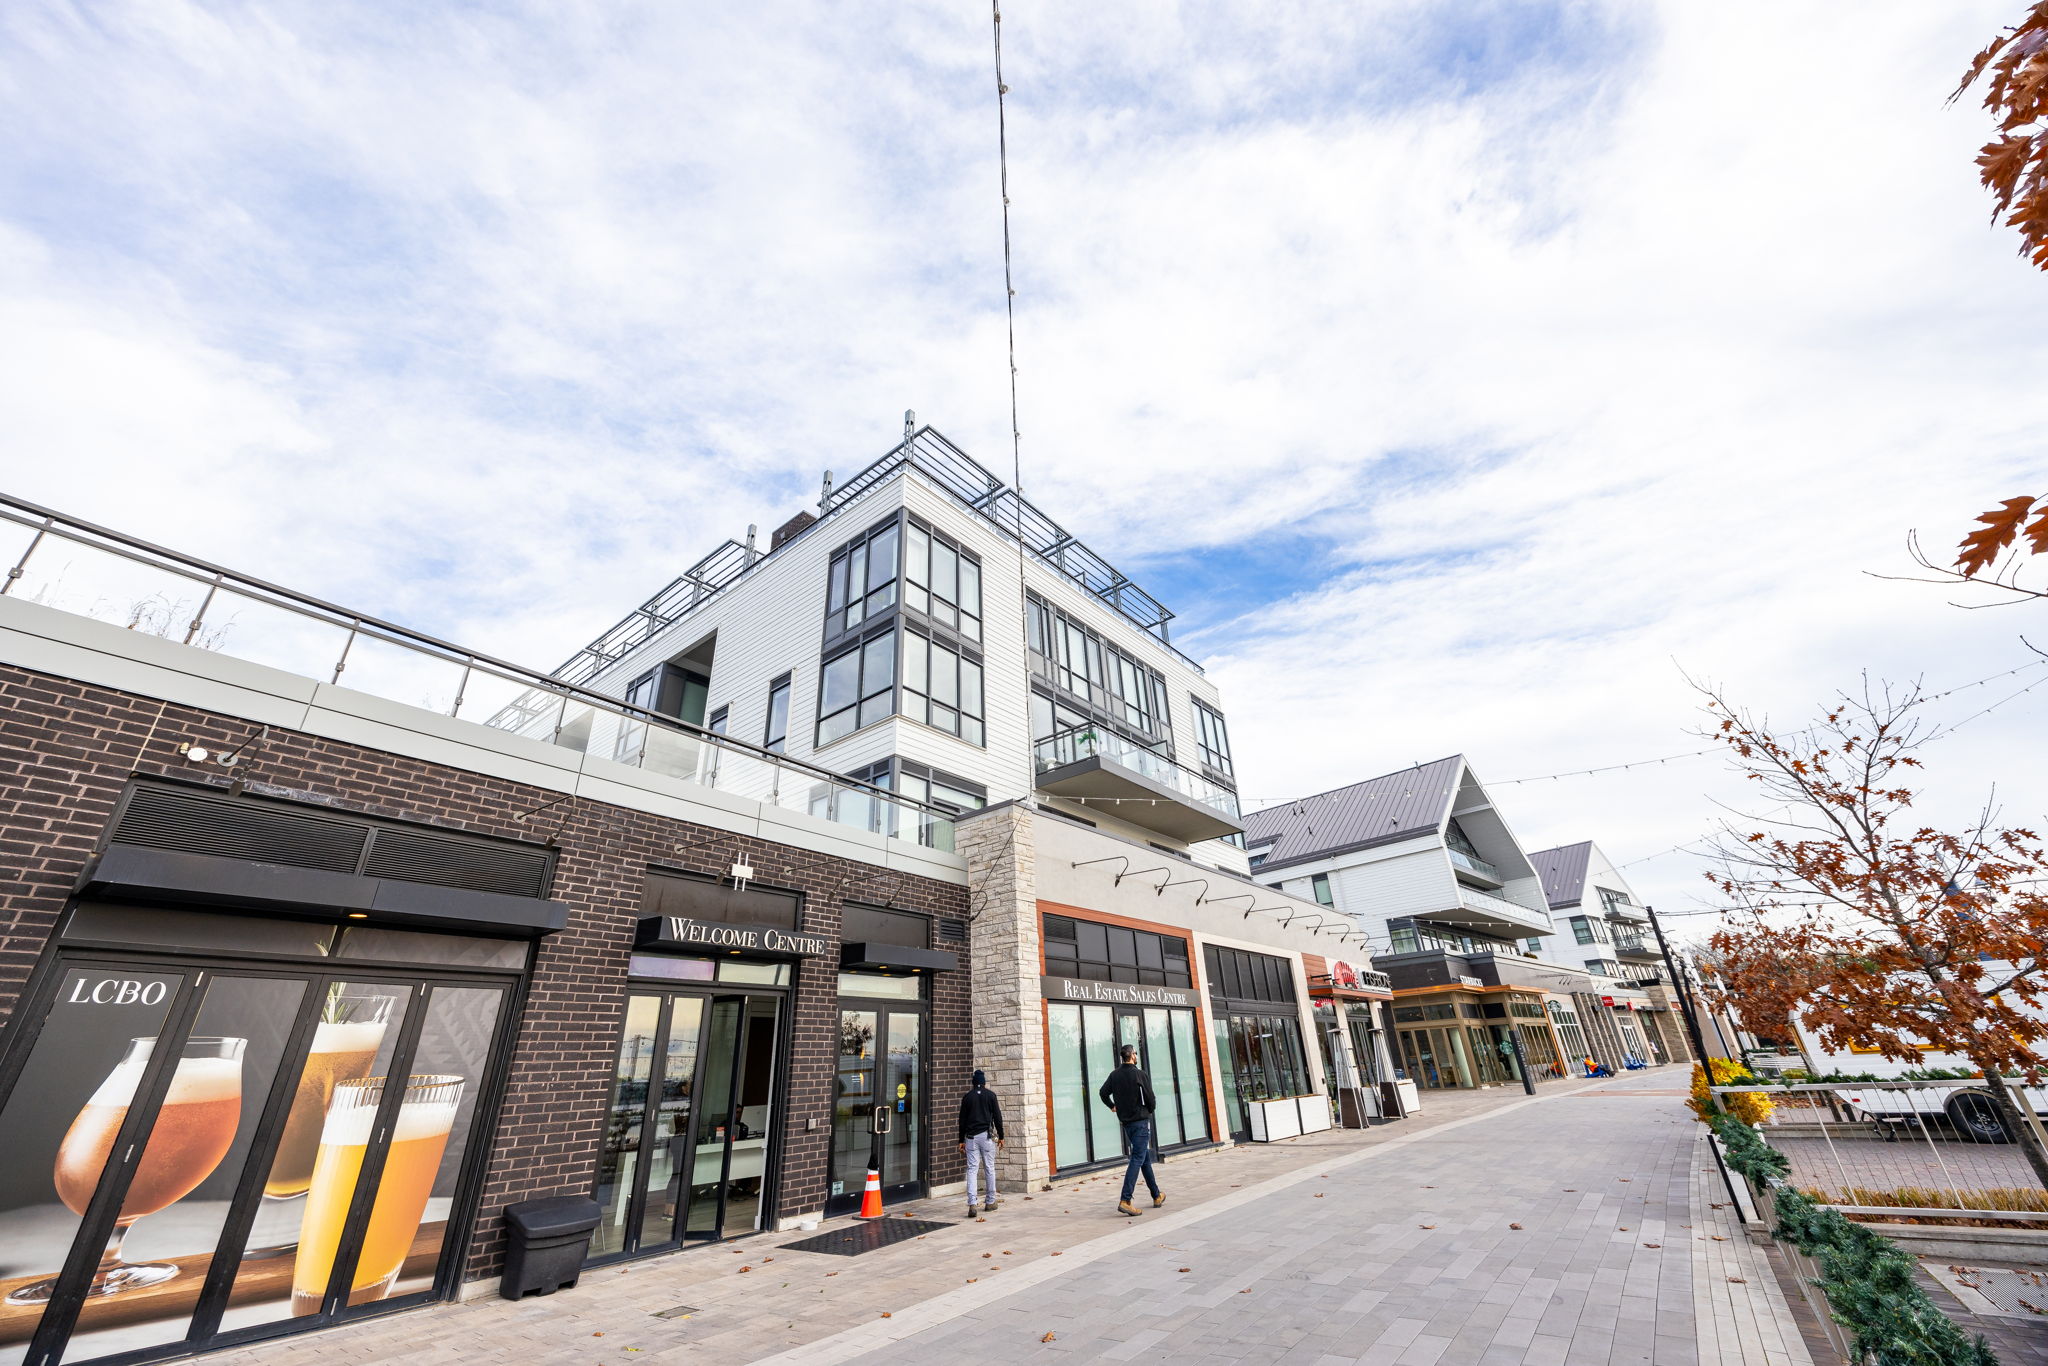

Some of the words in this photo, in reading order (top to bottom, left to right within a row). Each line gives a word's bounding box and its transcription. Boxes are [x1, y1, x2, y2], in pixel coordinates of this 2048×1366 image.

[669, 916, 758, 948] WELCOME
[763, 929, 825, 955] CENTRE
[67, 978, 167, 1006] LCBO
[1063, 979, 1092, 999] REAL
[1094, 982, 1128, 1002] ESTATE
[1129, 985, 1157, 1004] SALES
[1157, 987, 1188, 1005] CENTRE
